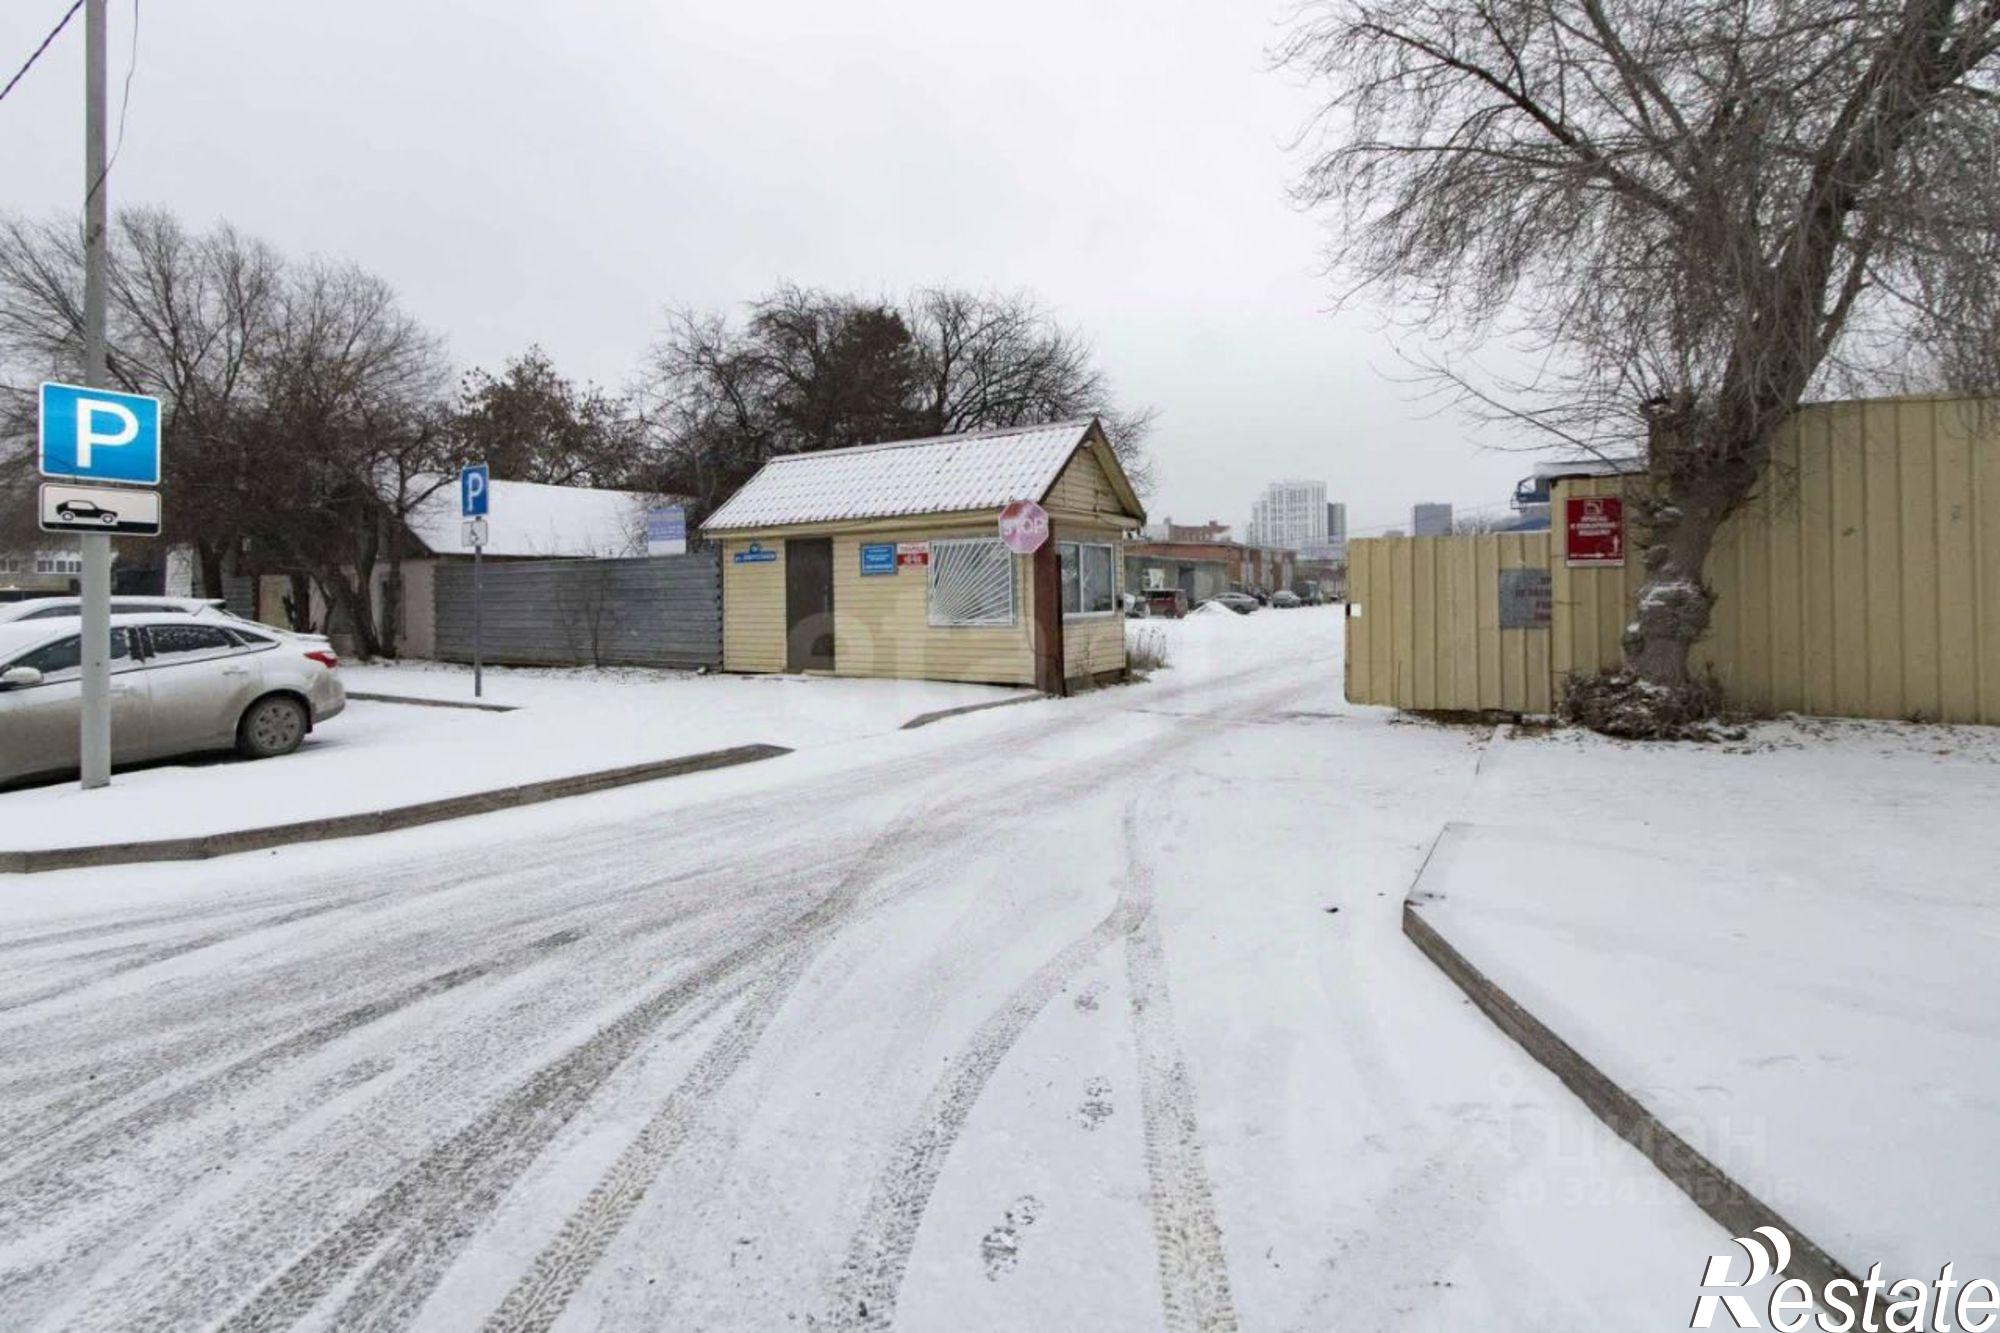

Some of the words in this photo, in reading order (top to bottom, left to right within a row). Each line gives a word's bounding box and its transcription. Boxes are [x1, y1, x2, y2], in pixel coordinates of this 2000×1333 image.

[75, 397, 140, 469] P
[467, 472, 484, 512] P
[1002, 516, 1045, 536] STOP
